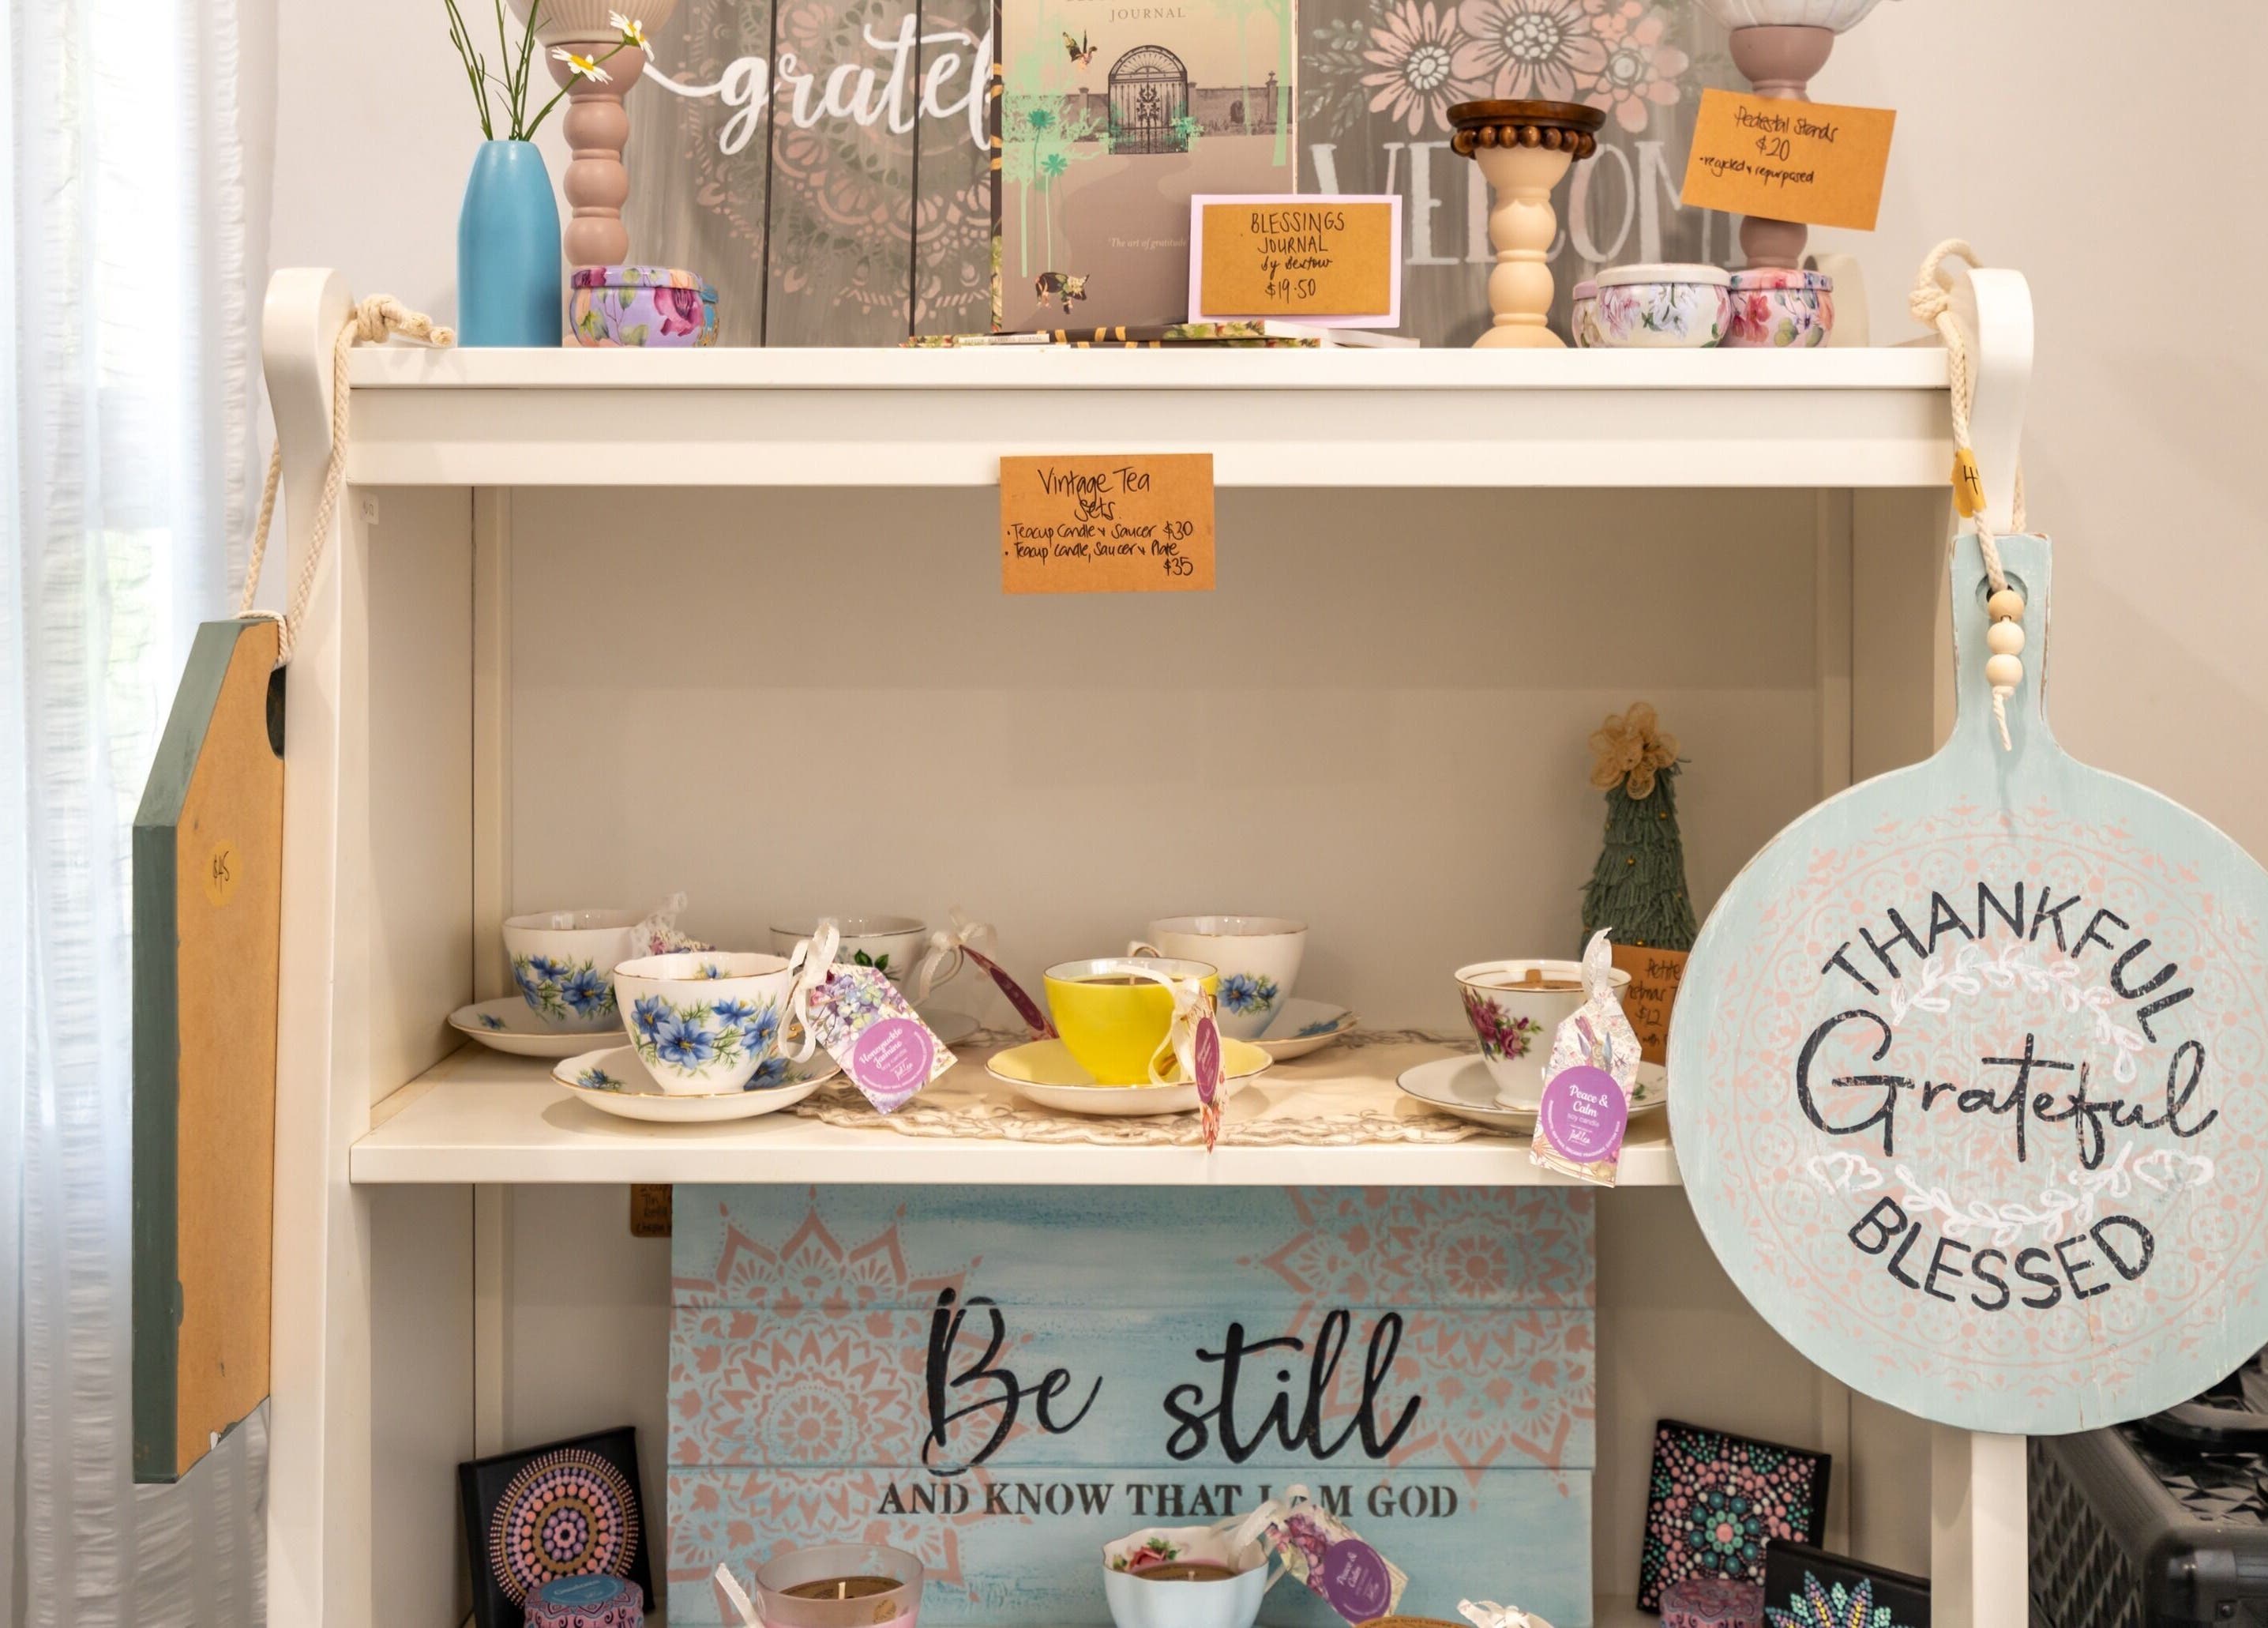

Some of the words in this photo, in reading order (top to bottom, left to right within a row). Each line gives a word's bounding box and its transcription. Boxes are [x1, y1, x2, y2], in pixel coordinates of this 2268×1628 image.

[1109, 7, 1186, 23] JOURNAL
[1734, 105, 1790, 134] Pedestal
[1793, 118, 1839, 144] Stands
[1755, 135, 1791, 162] $20
[1754, 165, 1816, 189] repurposed
[1251, 211, 1345, 235] BLESSINGS
[1257, 235, 1329, 254] JOURNAL
[1261, 254, 1281, 280] by
[1037, 467, 1113, 506] Vintage
[1113, 466, 1151, 494] Tea
[1011, 522, 1054, 550] Teacup
[1057, 523, 1096, 539] Candle
[1111, 523, 1157, 540] Saucer
[1162, 521, 1193, 540] $30
[1013, 541, 1050, 566] Teacup
[1093, 541, 1137, 556] Saucer
[1151, 539, 1180, 557] Plate
[1162, 556, 1194, 576] $35
[1821, 881, 2195, 1043] THANKFUL
[873, 1040, 903, 1069] Jasmine
[1569, 1084, 1598, 1104] Peace
[1598, 1094, 1609, 1108] &
[1797, 1008, 2219, 1171] Grateful
[1572, 1100, 1598, 1118] Calm
[1847, 1195, 2156, 1312] BLESSED
[922, 1286, 1103, 1477] Be
[1162, 1308, 1422, 1464] still
[877, 1482, 970, 1515] AND
[983, 1483, 1115, 1515] KNOW
[1126, 1484, 1243, 1517] THAT
[1367, 1485, 1459, 1518] GOD
